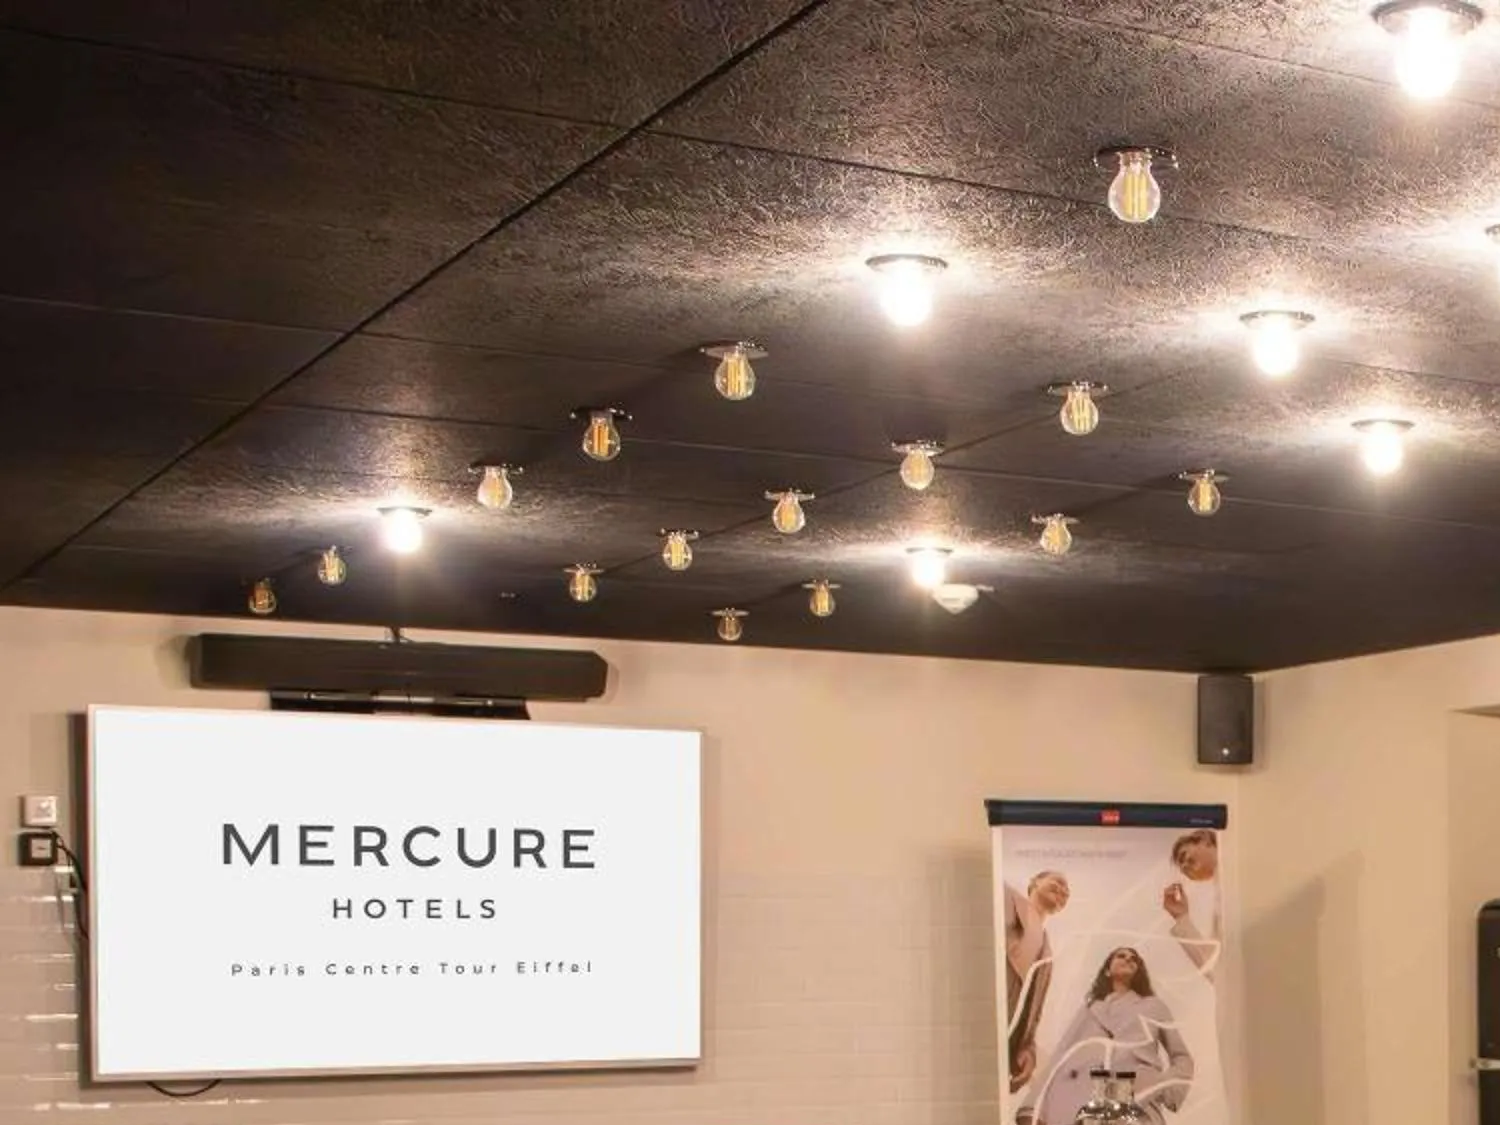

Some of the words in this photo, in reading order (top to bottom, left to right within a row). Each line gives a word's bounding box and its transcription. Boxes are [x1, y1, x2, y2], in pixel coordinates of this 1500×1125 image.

[222, 823, 595, 869] MERCURE
[332, 898, 496, 919] HOTELS
[231, 964, 305, 977] Paris
[325, 963, 419, 976] Centre
[440, 962, 496, 975] Tour
[517, 961, 592, 974] Eiffel
